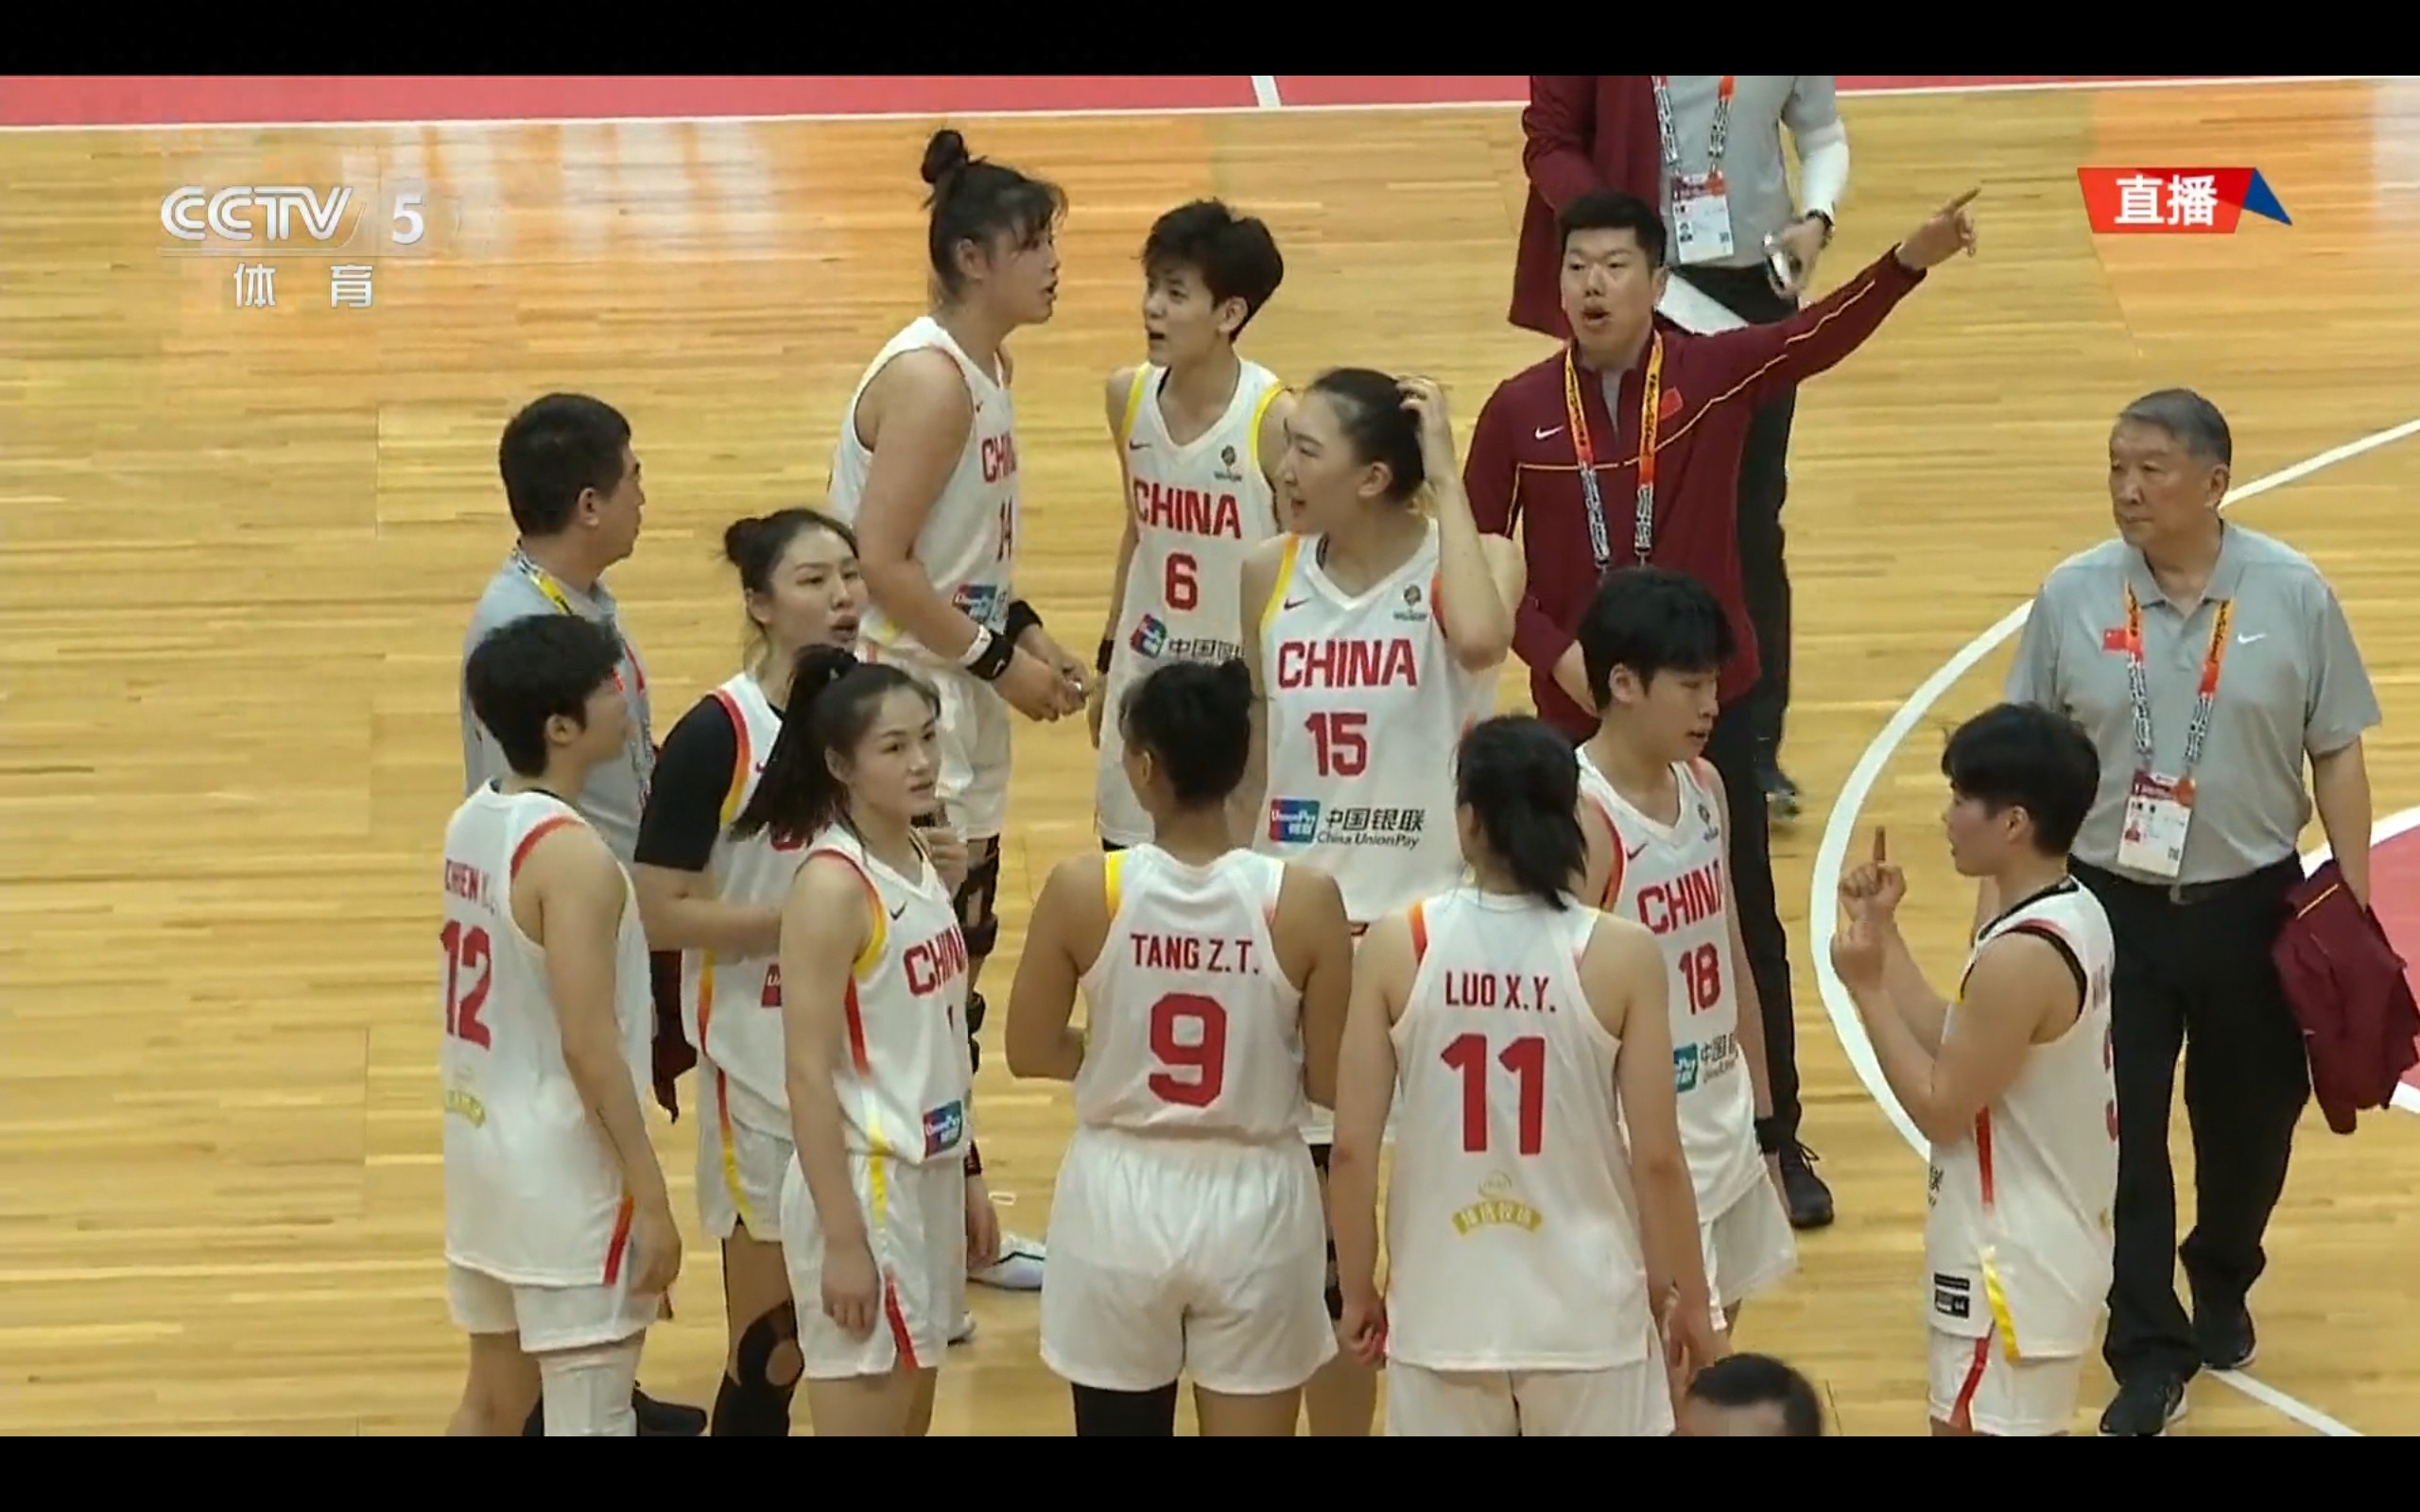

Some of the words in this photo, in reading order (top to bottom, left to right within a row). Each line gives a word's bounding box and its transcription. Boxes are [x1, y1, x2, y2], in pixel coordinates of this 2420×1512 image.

[1133, 478, 1241, 539] CHINA
[1165, 552, 1198, 611] 6
[1278, 638, 1418, 689] CHINA
[1304, 713, 1368, 777] 15
[1318, 831, 1352, 846] China
[1354, 833, 1420, 850] UnionPay
[1325, 807, 1426, 832] 中国银联
[1130, 933, 1201, 971] TANG
[1678, 942, 1720, 1016] 18
[440, 919, 491, 1052] 12
[1444, 971, 1496, 1007] LUO
[1148, 992, 1227, 1108] 9
[1441, 1033, 1546, 1156] 11
